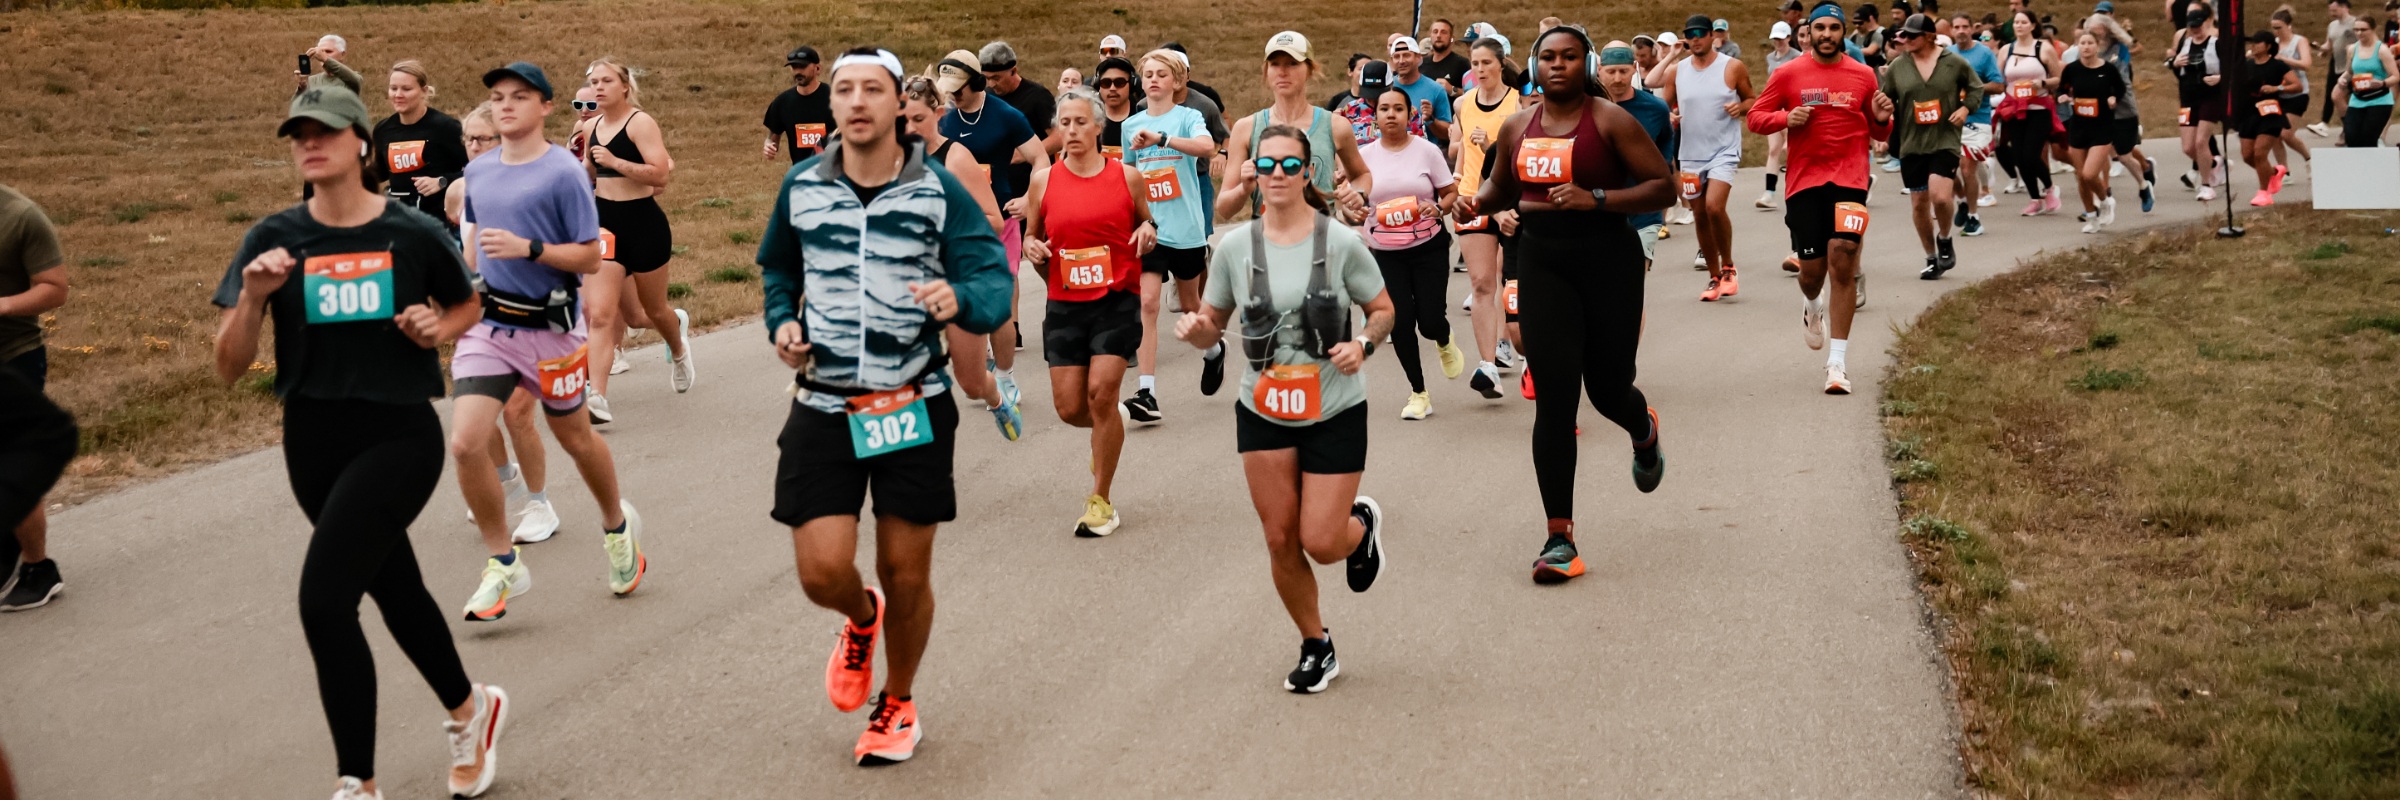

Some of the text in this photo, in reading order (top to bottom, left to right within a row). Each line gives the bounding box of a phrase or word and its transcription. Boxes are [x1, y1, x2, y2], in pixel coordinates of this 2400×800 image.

[1918, 109, 1939, 122] 533
[393, 152, 419, 170] 504
[1526, 156, 1562, 178] 524
[1148, 180, 1174, 199] 576
[1385, 209, 1414, 227] 494
[1843, 214, 1865, 232] 477
[1069, 264, 1105, 286] 453
[318, 280, 381, 317] 300
[551, 366, 585, 398] 483
[1264, 386, 1307, 415] 410
[863, 411, 920, 450] 302
